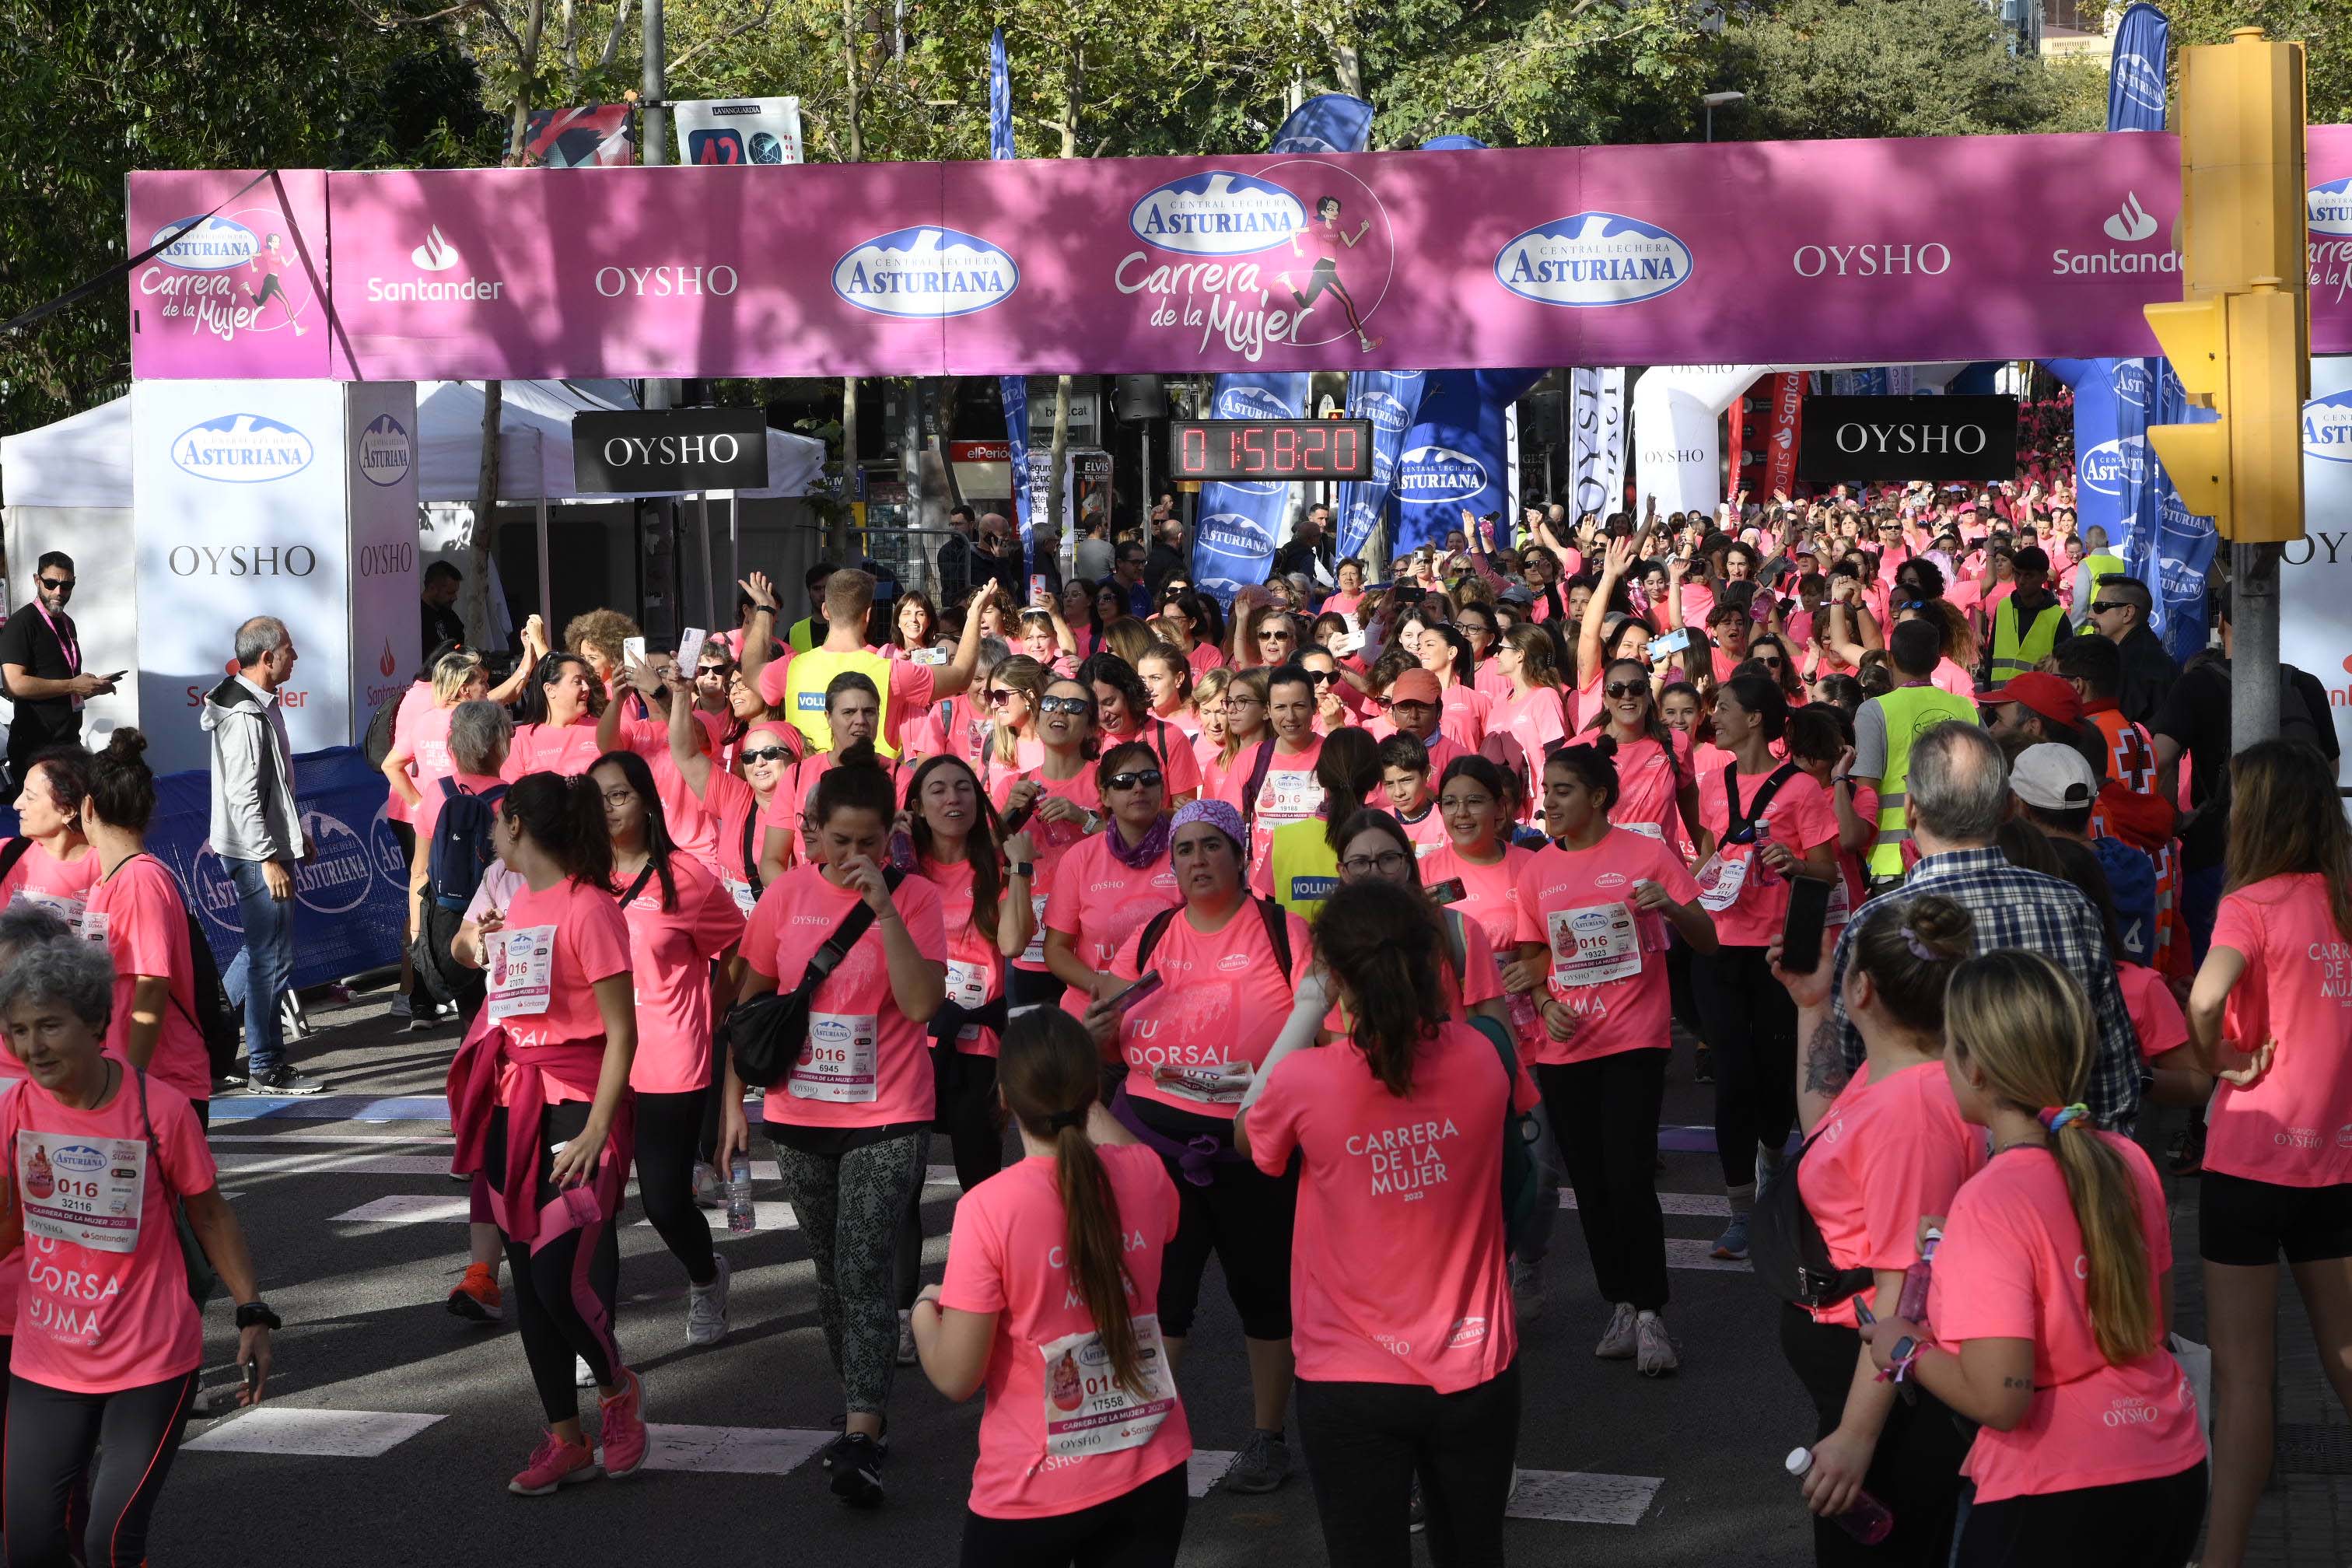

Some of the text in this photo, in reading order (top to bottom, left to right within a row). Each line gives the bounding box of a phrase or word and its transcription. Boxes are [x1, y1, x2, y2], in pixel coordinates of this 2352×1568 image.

[1170, 198, 1288, 209] CENTRAL LECHERA
[1143, 203, 1293, 235] ASTURIANA
[158, 235, 250, 257] ASTURIANA
[1539, 243, 1671, 255] CENTRAL LECHERA
[874, 256, 999, 268] CENTRAL LECHERA
[1510, 248, 1678, 283] ASTURIANA
[1793, 242, 1951, 277] OYSHO
[2053, 249, 2182, 275] Santand
[140, 265, 232, 297] Carrera
[595, 265, 737, 297] OYSHO
[846, 261, 1005, 294] ASTURIANA
[1115, 251, 1260, 294] Carrera
[367, 277, 503, 302] Santander
[162, 292, 265, 341] de la Mujer
[1151, 287, 1314, 362] de la Mujer
[1836, 422, 1986, 454] OYSHO
[182, 439, 303, 465] ASTURIANA
[362, 445, 408, 469] ASTURIANA
[604, 432, 739, 467] OYSHO
[1645, 449, 1704, 464] OYSHO
[1085, 462, 1108, 471] ELVIS
[1392, 474, 1481, 492] ASTURIANA
[1199, 523, 1269, 554] ASTURIANA
[169, 544, 317, 576] OYSHO
[361, 542, 412, 577] OYSHO
[294, 854, 369, 894] ASTURIANA
[1090, 880, 1125, 892] OYSHO
[1538, 883, 1567, 901] OYSHO
[792, 915, 830, 926] OYSHO
[1573, 920, 1606, 929] ASTURIANA
[1580, 935, 1608, 949] 016
[1094, 943, 1115, 961] TU
[1585, 949, 1607, 959] 19323
[508, 962, 527, 976] 016
[1564, 962, 1587, 971] CARRERA
[2324, 961, 2343, 979] DE
[509, 978, 524, 988] 27070
[1563, 972, 1590, 982] OYSHO
[814, 1026, 849, 1038] ASTURIANA
[1132, 1020, 1159, 1039] TU
[815, 1048, 846, 1062] 016
[1130, 1045, 1233, 1065] DORSAL
[819, 1064, 839, 1073] 6945
[794, 1084, 818, 1094] OYSHO
[1346, 1118, 1459, 1157] CARRERA
[2274, 1133, 2323, 1149] OYSHO
[55, 1153, 103, 1167] ASTURIANA
[1371, 1143, 1441, 1174] DE LA
[58, 1178, 99, 1198] 016
[1370, 1164, 1448, 1196] MUJER
[62, 1199, 92, 1213] 32116
[1404, 1191, 1424, 1202] 2023
[33, 1207, 63, 1219] CARRERA
[84, 1216, 108, 1226] MUJER
[31, 1219, 128, 1243] OYSHO Santander
[1092, 1395, 1124, 1412] 17558
[1062, 1418, 1097, 1431] CARRERA
[1109, 1413, 1118, 1422] LA
[1119, 1408, 1146, 1420] MUJER
[1147, 1403, 1165, 1413] 2023
[2103, 1405, 2158, 1426] OYSHO
[1060, 1434, 1101, 1451] OYSHO
